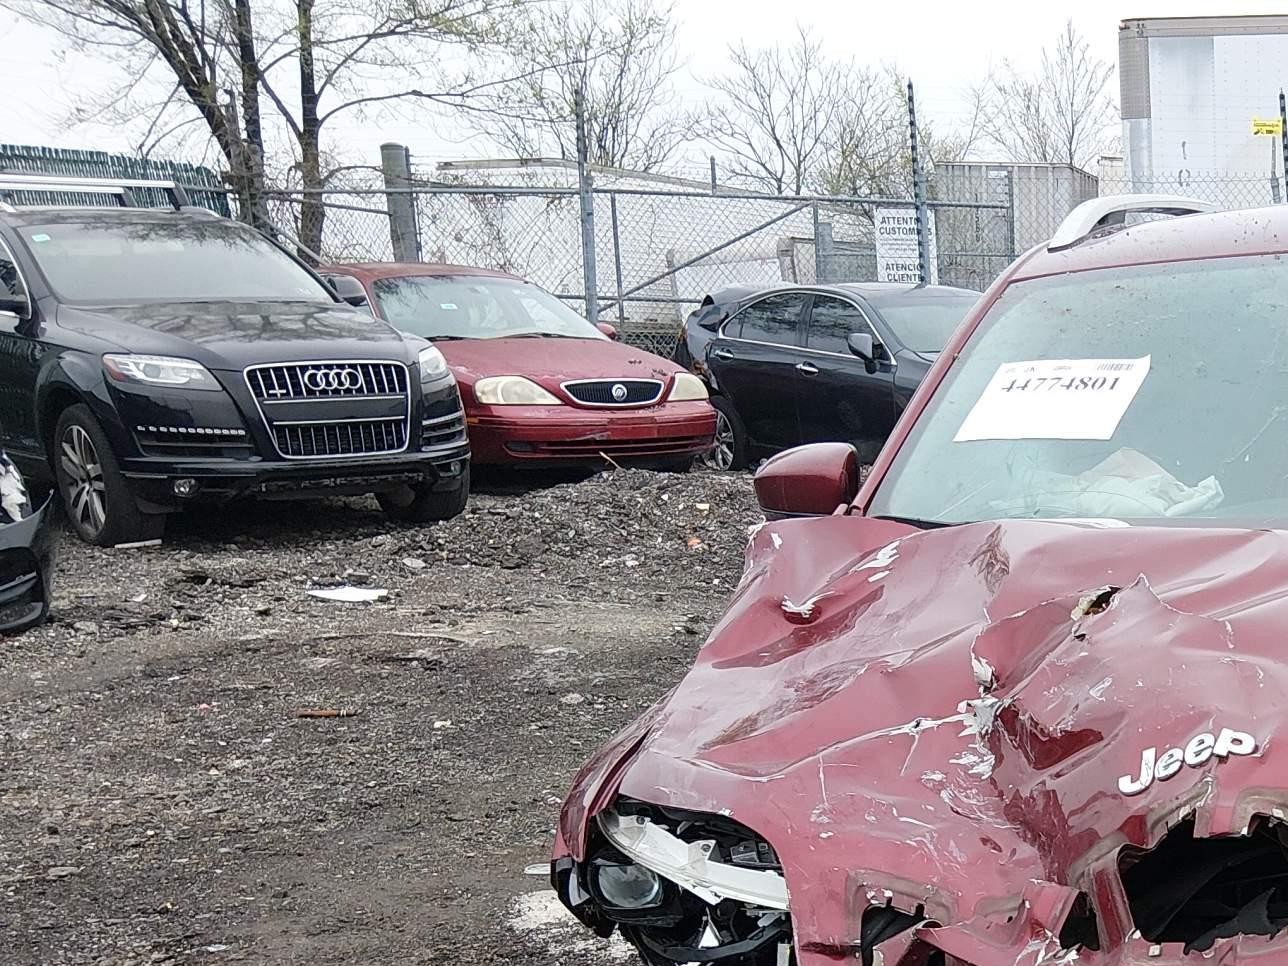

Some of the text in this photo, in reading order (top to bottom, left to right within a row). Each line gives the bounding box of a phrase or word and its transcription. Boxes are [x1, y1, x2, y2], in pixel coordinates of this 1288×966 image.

[879, 227, 933, 236] CUSTOMS
[886, 263, 924, 272] ATENCIO
[887, 273, 923, 282] CLIENTE
[1001, 376, 1121, 393] 44774801
[1118, 727, 1258, 797] Jeep
